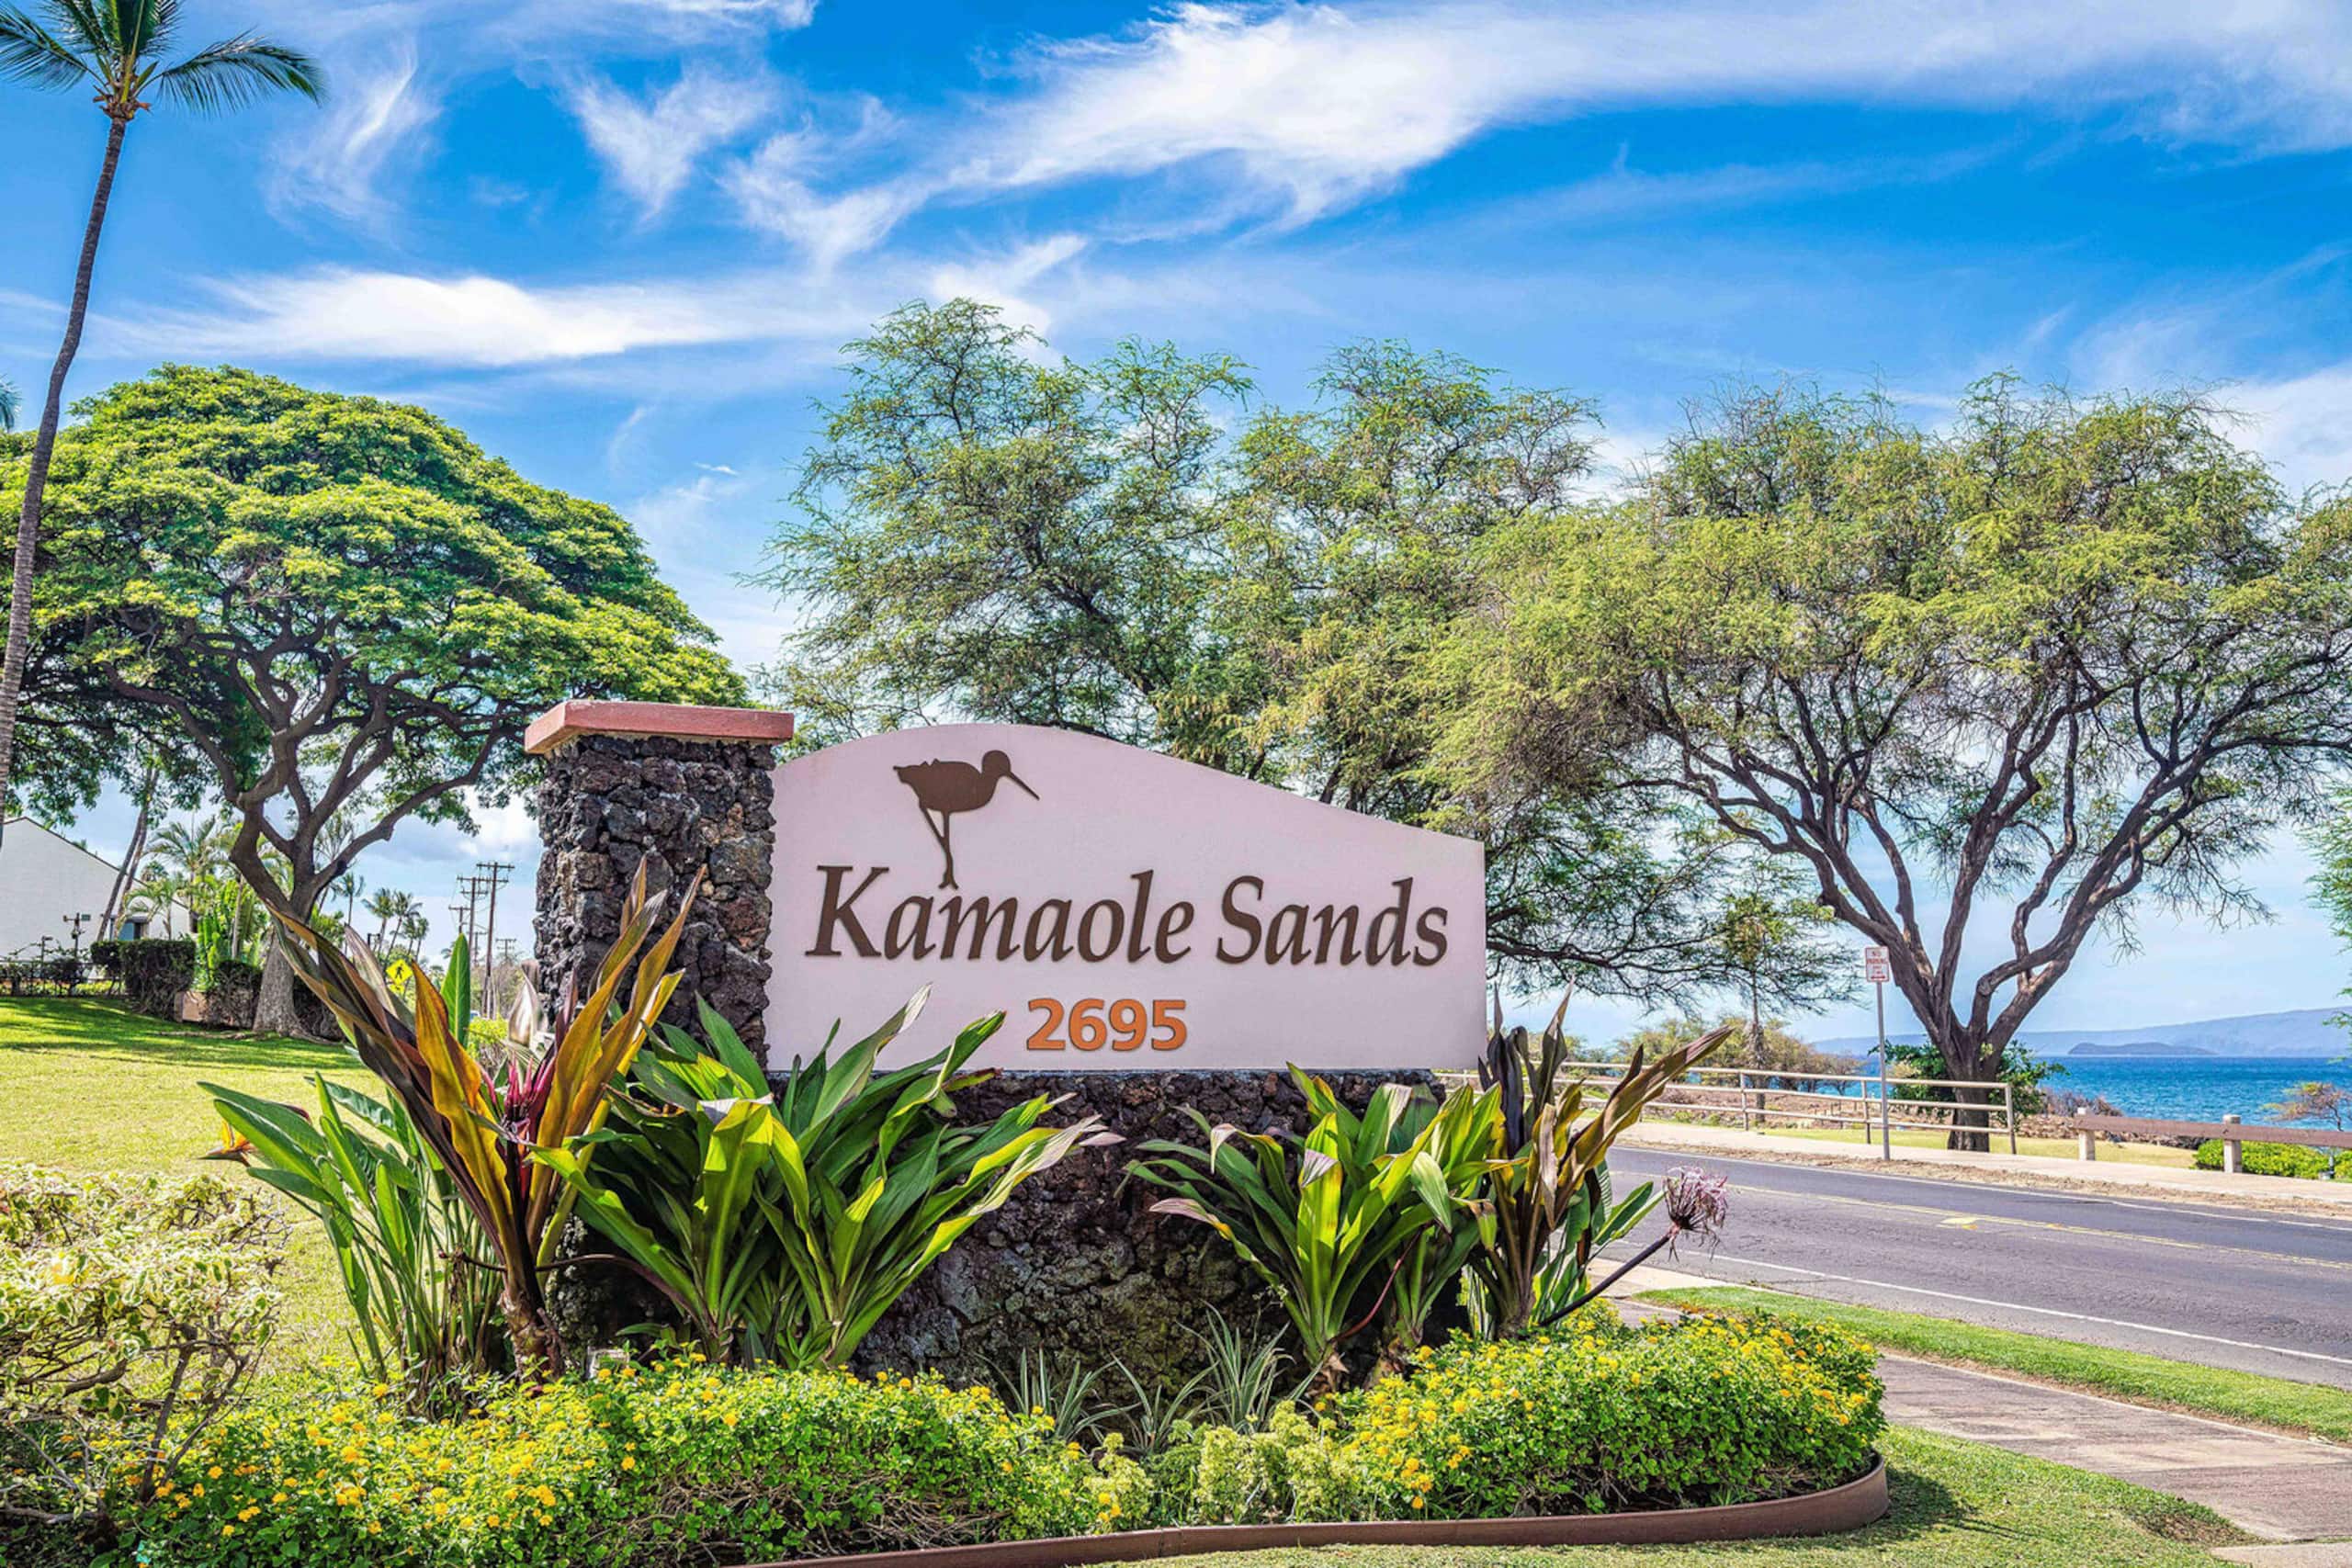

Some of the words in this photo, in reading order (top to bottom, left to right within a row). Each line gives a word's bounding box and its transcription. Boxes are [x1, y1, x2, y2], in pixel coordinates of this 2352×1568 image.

[805, 865, 1195, 964] Kamaole
[1216, 875, 1449, 967] Sands
[1026, 998, 1188, 1052] 2695
